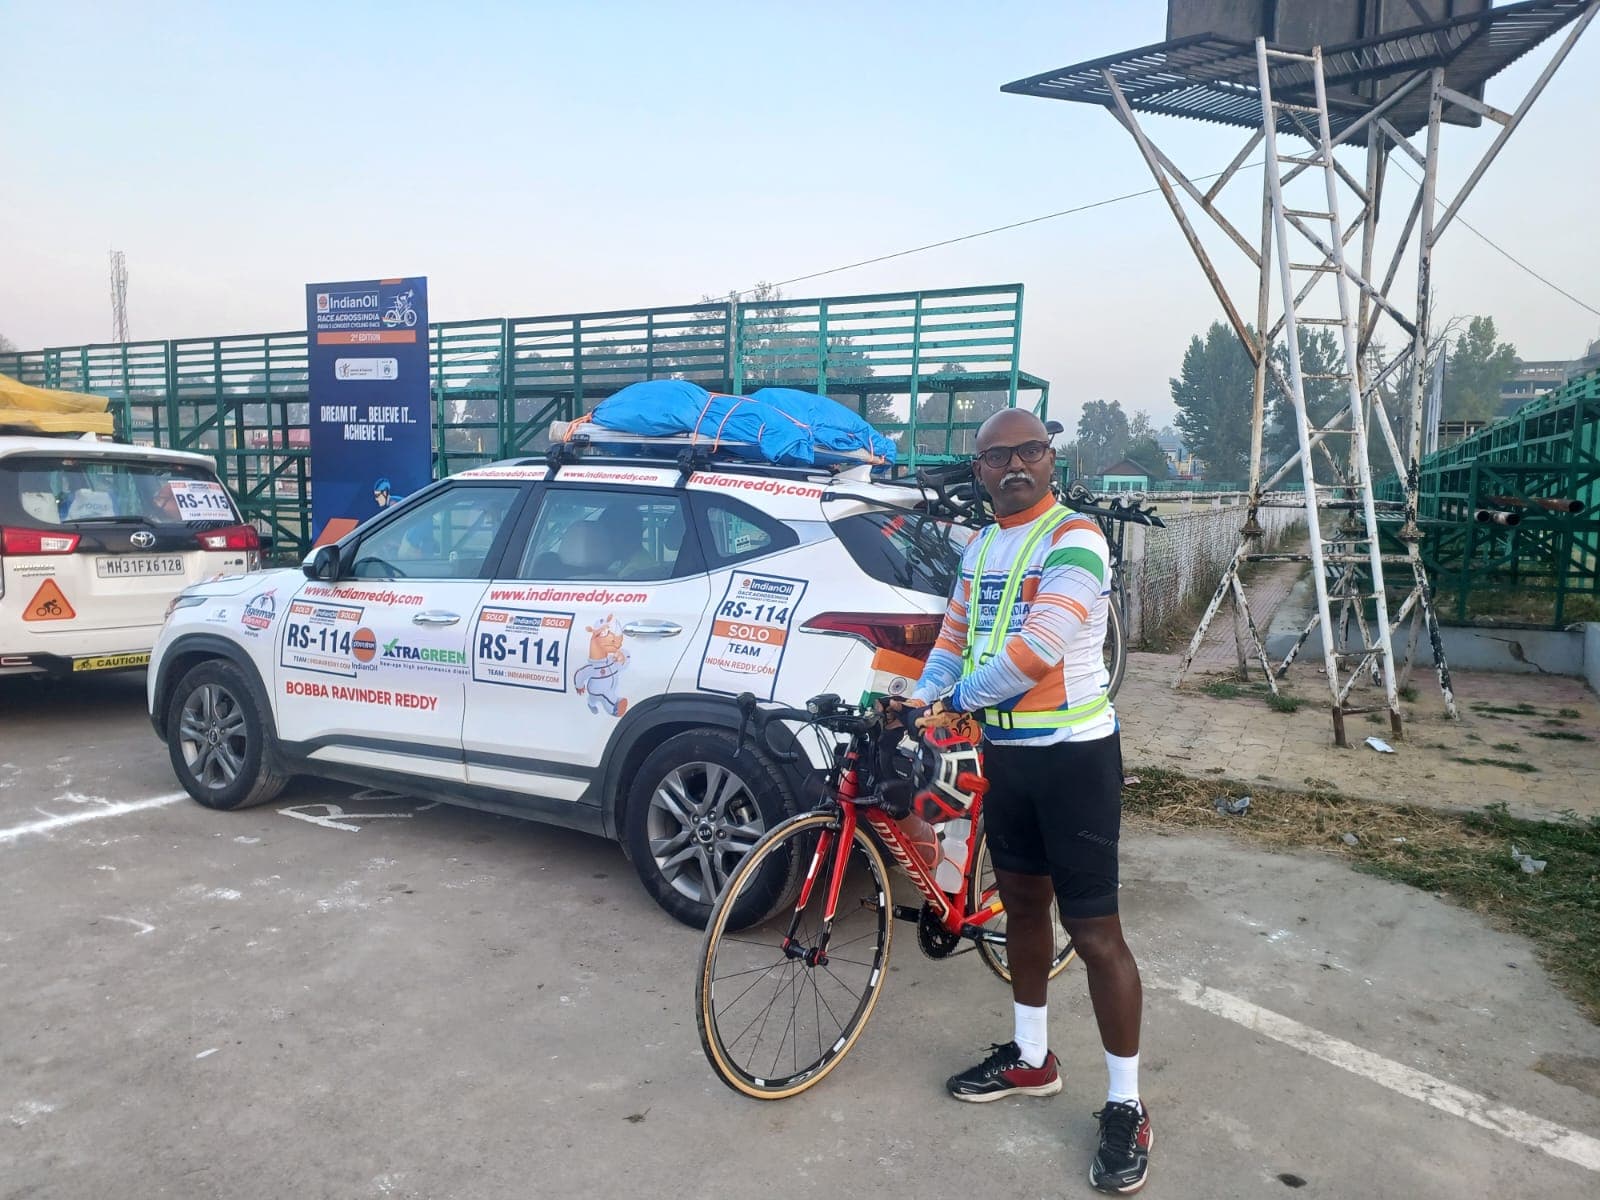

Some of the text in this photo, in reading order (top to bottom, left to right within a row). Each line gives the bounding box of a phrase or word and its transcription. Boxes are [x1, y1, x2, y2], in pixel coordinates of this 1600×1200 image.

[330, 295, 378, 309] IndianOil
[320, 405, 348, 422] DREAM
[350, 406, 357, 422] IT
[368, 406, 399, 423] BELIEVE
[344, 424, 376, 440] ACHIEVE
[688, 472, 822, 498] indianreddy.com
[175, 493, 230, 510] RS-115
[304, 585, 424, 607] www.indianreddy.com
[490, 587, 648, 606] www.indianreddy.com
[751, 581, 793, 595] IndianOil
[486, 613, 505, 622] SOLO
[545, 618, 566, 627] SOLO
[720, 600, 789, 625] RS-114
[287, 623, 351, 655] RS-114
[728, 624, 770, 642] SOLO
[479, 632, 560, 667] RS-114
[728, 642, 762, 657] TEAM
[96, 656, 144, 668] CAUTION
[286, 681, 438, 711] BOBBA RAVINDER REDDY
